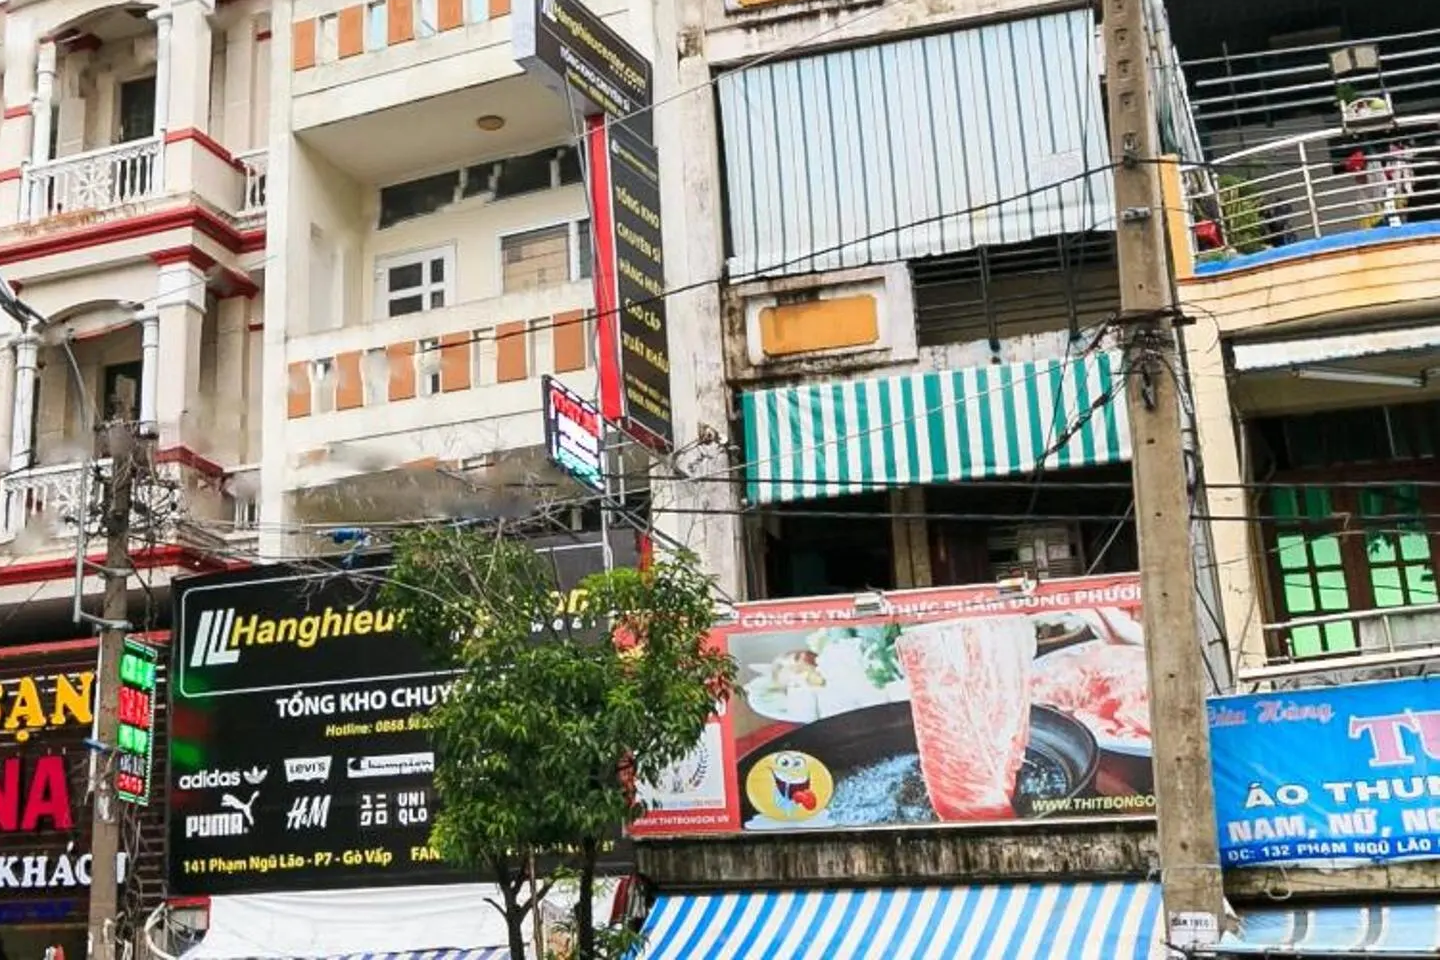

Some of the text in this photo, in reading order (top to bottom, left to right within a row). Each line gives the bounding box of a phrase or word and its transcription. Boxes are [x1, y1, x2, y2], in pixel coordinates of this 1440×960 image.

[801, 609, 824, 624] TY
[275, 690, 336, 719] TỔNG
[339, 690, 387, 713] KHO
[1253, 699, 1337, 725] Hàng
[325, 722, 373, 738] Hotline:
[178, 767, 241, 790] adidas
[1244, 781, 1310, 809] ÁO
[185, 791, 426, 839] PUMA H&M UNI
[397, 807, 428, 826] QLO
[1227, 814, 1318, 843] NAM,
[1260, 844, 1291, 858] 132
[1296, 841, 1347, 856] PHẠM
[1353, 838, 1390, 855] NGŨ
[1396, 836, 1432, 853] LÃO
[183, 859, 206, 873] 141
[209, 857, 248, 876] Phạm
[249, 854, 278, 874] Ngũ
[279, 853, 305, 869] Lão
[313, 851, 333, 867] P7
[342, 849, 363, 866] Gò
[364, 845, 393, 867] Vấp
